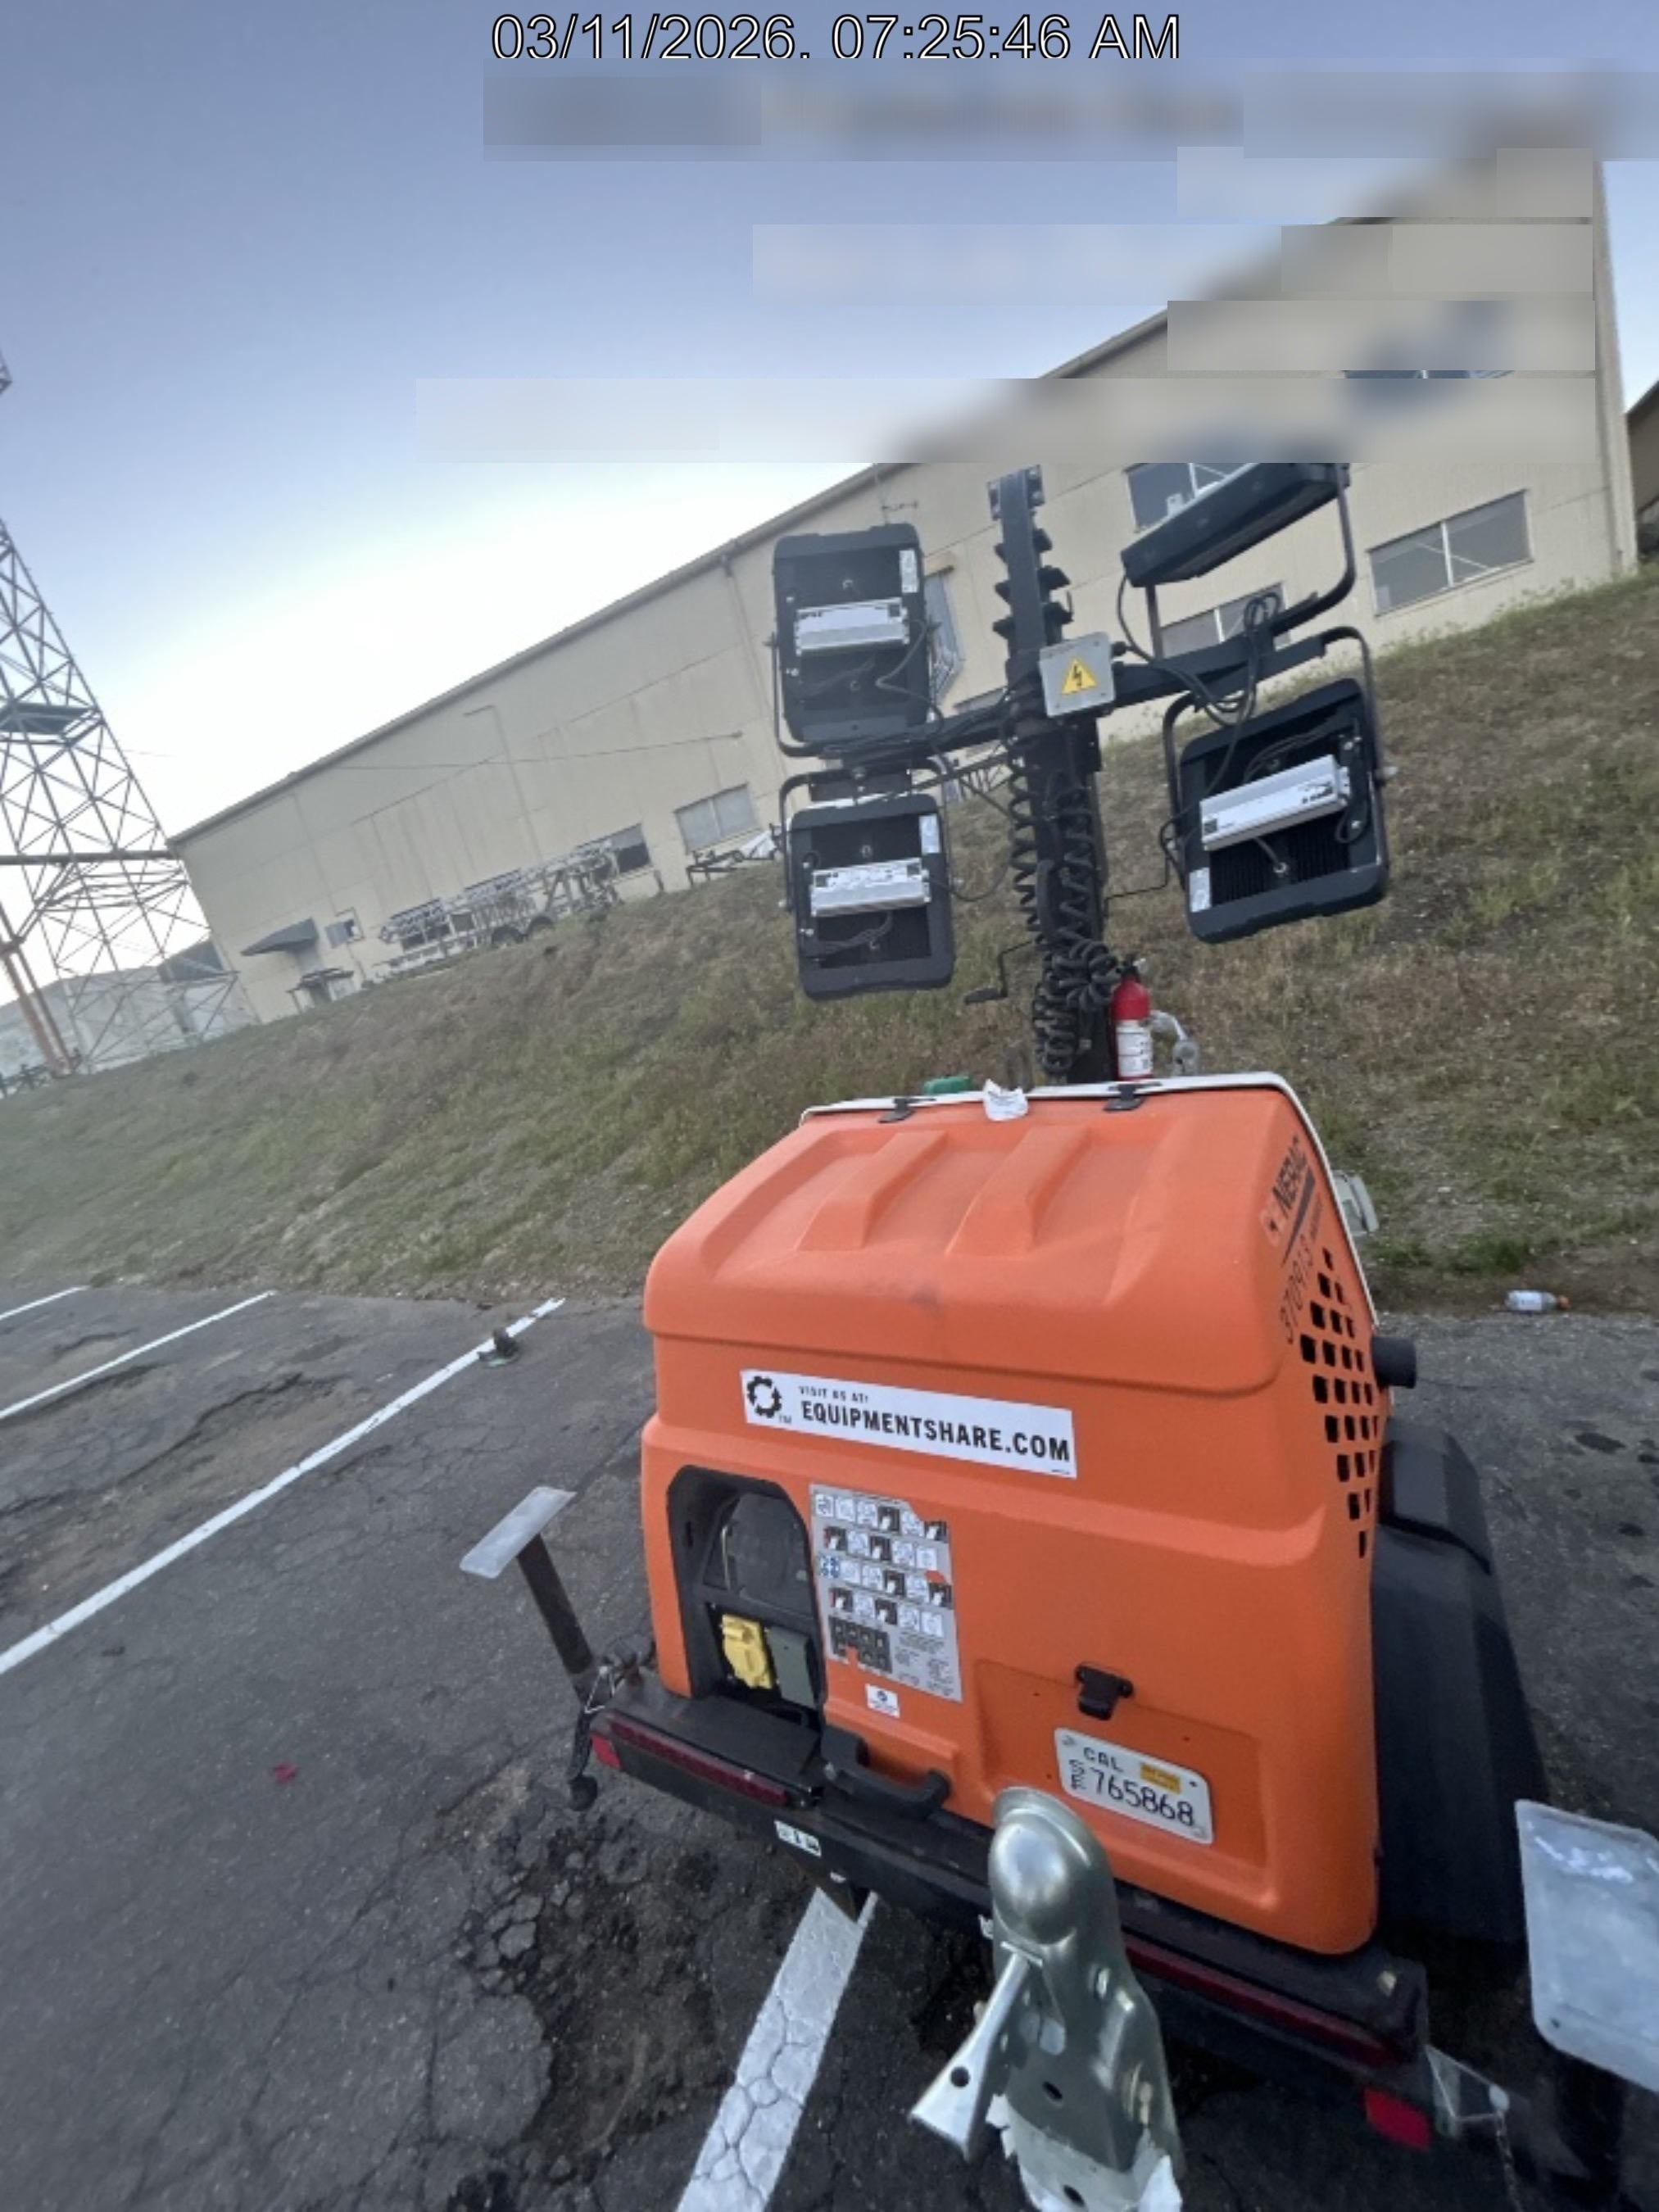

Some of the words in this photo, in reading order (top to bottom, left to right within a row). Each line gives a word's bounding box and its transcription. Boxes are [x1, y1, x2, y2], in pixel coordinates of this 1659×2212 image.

[800, 1400, 1071, 1462] EQUIPMENTSHARE.COM
[1083, 1747, 1124, 1773] CAL
[1090, 1766, 1195, 1827] 765868
